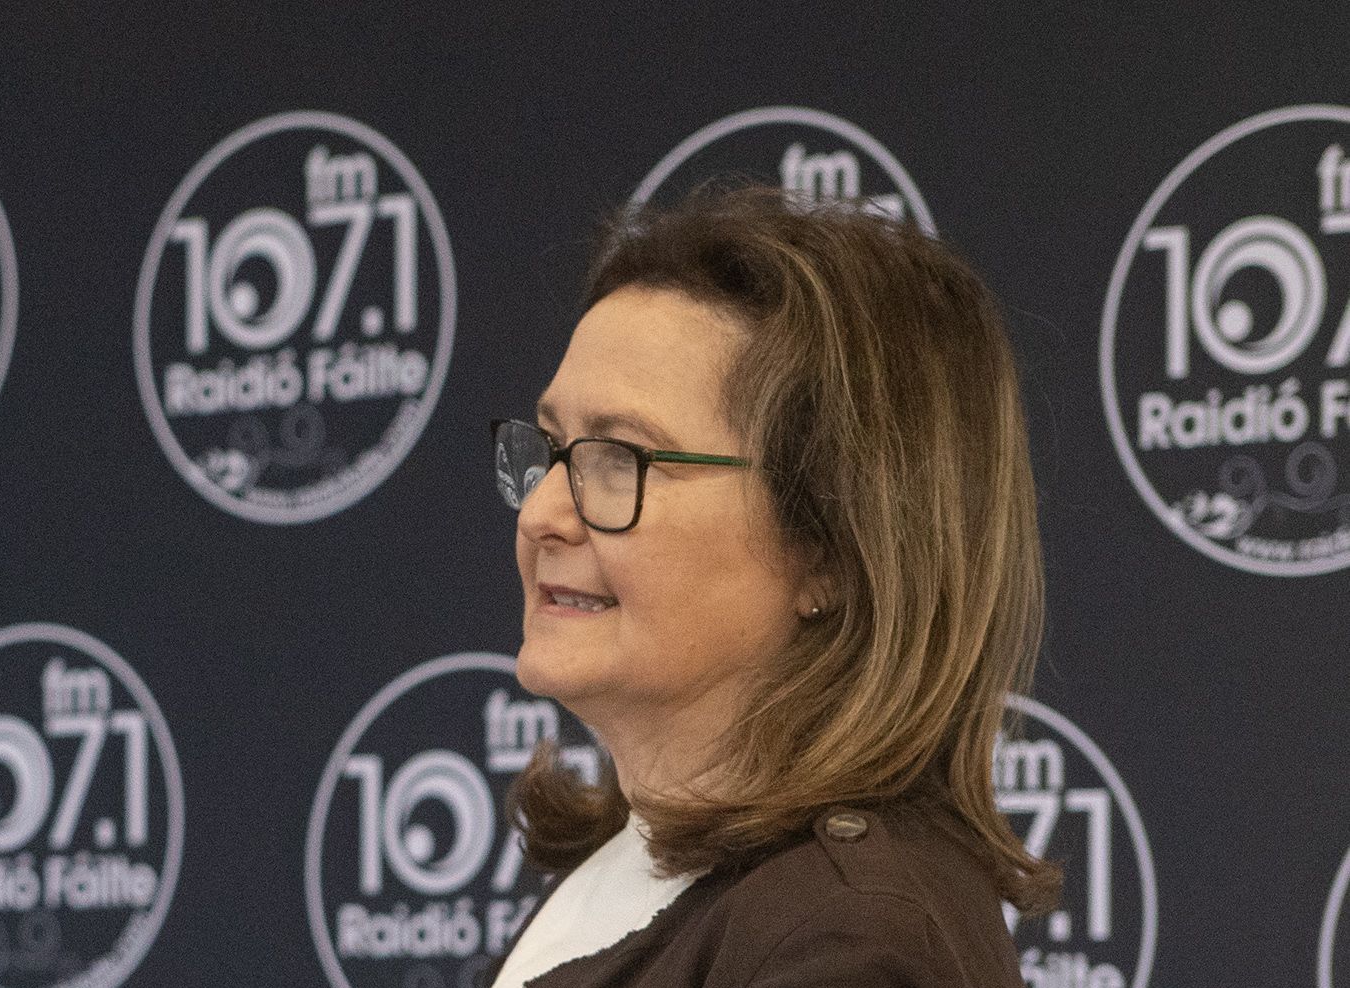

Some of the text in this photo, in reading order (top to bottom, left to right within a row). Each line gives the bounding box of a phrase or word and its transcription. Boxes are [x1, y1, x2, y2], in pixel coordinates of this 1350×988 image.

[308, 150, 375, 196] fm
[783, 146, 857, 197] fm
[173, 202, 414, 351] 107.1
[168, 347, 426, 411] Raidió Fáilte
[1142, 381, 1306, 446] Raidió
[45, 661, 107, 712] fm
[486, 692, 556, 745] fm
[340, 901, 478, 955] Raidió
